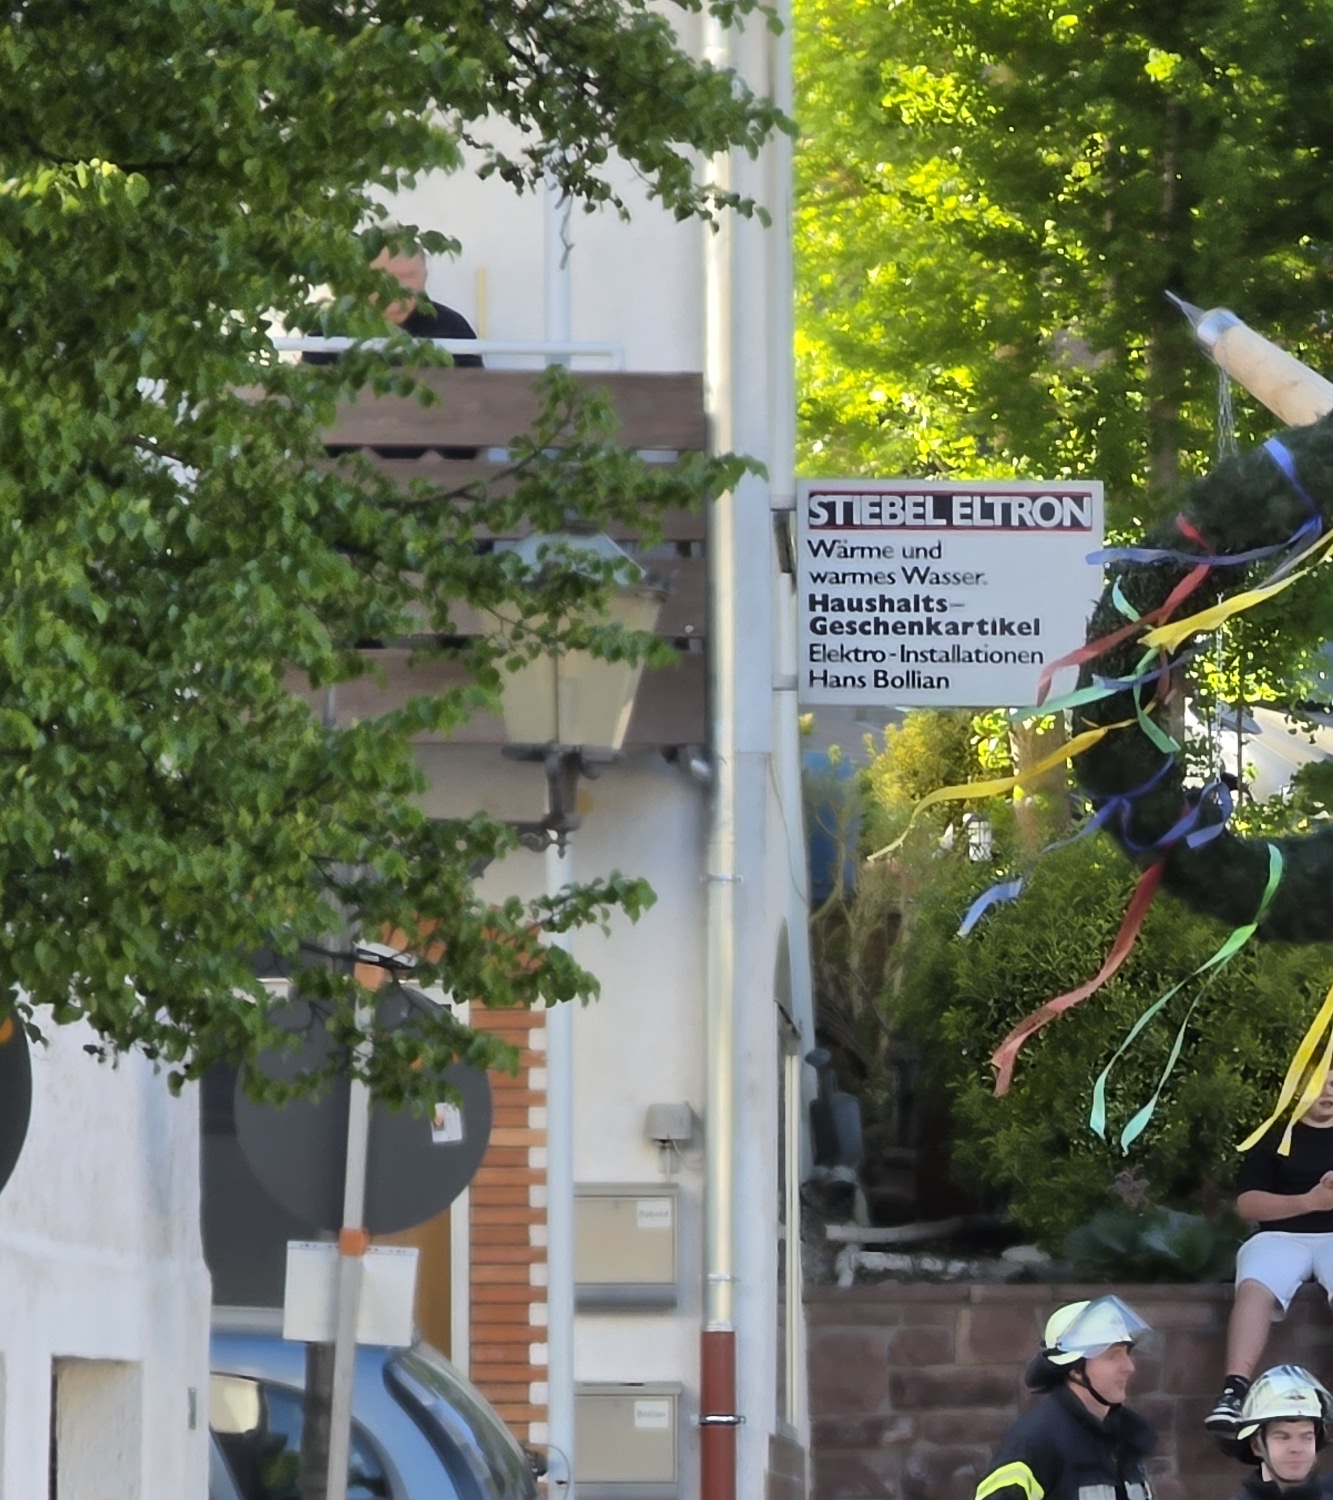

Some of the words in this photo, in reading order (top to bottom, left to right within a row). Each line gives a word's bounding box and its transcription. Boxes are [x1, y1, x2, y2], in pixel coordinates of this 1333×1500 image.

[808, 494, 947, 527] STIEBEL
[952, 495, 1092, 528] ELTRON
[806, 538, 895, 561] Wärme
[901, 540, 943, 560] und
[808, 569, 897, 586] warmes
[901, 565, 989, 587] Wasser.
[808, 616, 1041, 637] Geschenkartikel
[808, 669, 867, 689] Hans
[873, 669, 950, 690] Bollian
